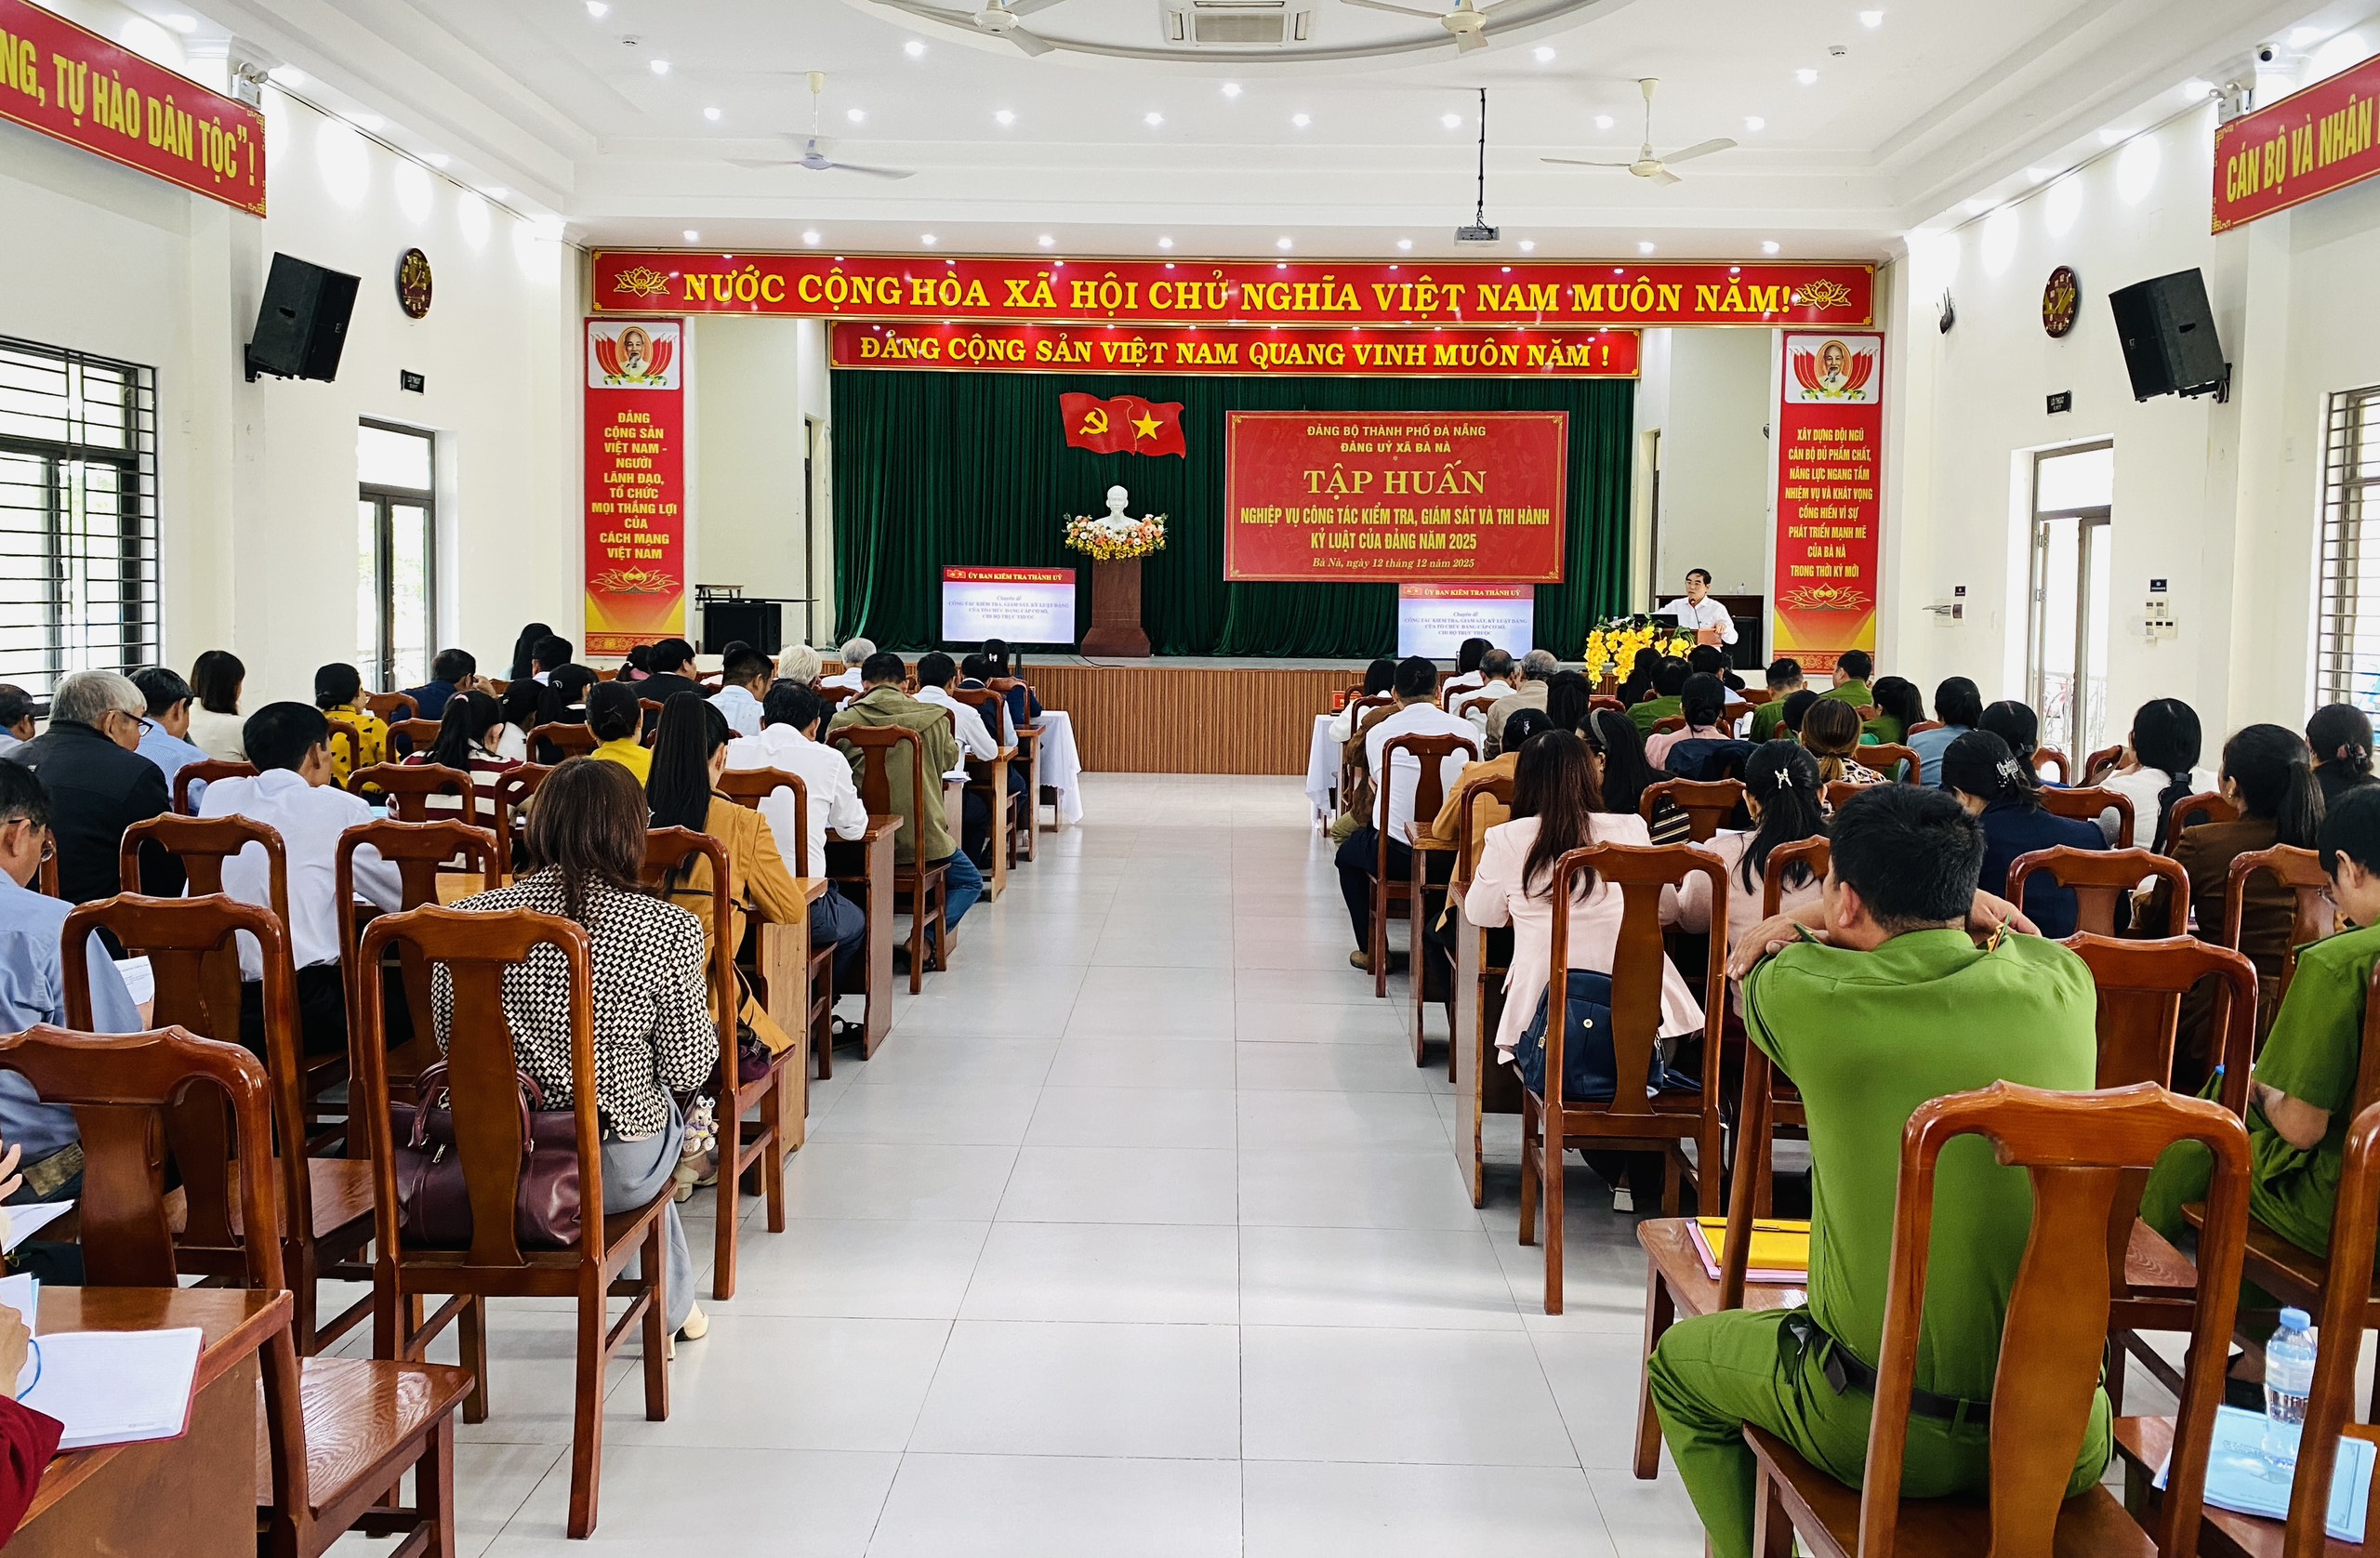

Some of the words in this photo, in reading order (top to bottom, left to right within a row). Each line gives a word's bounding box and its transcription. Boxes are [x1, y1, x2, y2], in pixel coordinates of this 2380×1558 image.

[53, 53, 87, 127] TỰ
[93, 70, 140, 139] HÀO
[147, 94, 193, 161] DÂN
[2227, 141, 2260, 203] CÁN
[2264, 125, 2287, 194] BỘ
[2292, 113, 2313, 178] VÀ
[2319, 93, 2373, 168] NHÂN
[683, 264, 786, 303] NƯỚC
[798, 266, 902, 311] CỘNG
[909, 270, 990, 307] HÒA
[1003, 271, 1057, 308] XÃ
[1070, 271, 1139, 317] HỘI
[1148, 269, 1229, 310] CHỦ
[1240, 274, 1362, 311] NGHĨA
[1371, 274, 1466, 320] VIỆT
[1476, 284, 1560, 311] NAM
[1571, 275, 1683, 312] MUÔN
[1695, 276, 1791, 313] NĂM!
[860, 329, 941, 360] ĐẢNG
[947, 332, 1026, 364] CỘNG
[1036, 332, 1093, 363] SẢN
[1100, 337, 1169, 368] VIỆT
[1176, 342, 1238, 364] NAM
[1249, 341, 1345, 370] QUANG
[1352, 344, 1426, 366] VINH
[1434, 337, 1519, 366] MUÔN
[1527, 337, 1591, 367] NĂM
[618, 409, 650, 423] ĐẢNG
[604, 426, 636, 440] CỘNG
[640, 425, 664, 439] SẢN
[1307, 424, 1340, 436] ĐẢNG
[1343, 425, 1358, 438] BỘ
[1363, 425, 1402, 436] THÀNH
[1406, 423, 1431, 436] PHỐ
[1434, 425, 1449, 436] ĐÀ
[1453, 423, 1486, 436] NẴNG
[1797, 427, 1812, 441] XÂY
[1813, 429, 1833, 443] DỰNG
[1834, 427, 1846, 443] ĐỘI
[604, 441, 628, 456] VIỆT
[632, 443, 659, 454] NAM
[1340, 441, 1373, 453] ĐẢNG
[1377, 441, 1393, 453] UỶ
[1395, 441, 1411, 453] XÃ
[1415, 441, 1431, 453] BÀ
[1435, 441, 1451, 453] NÀ
[1788, 446, 1804, 460] CÁN
[1805, 446, 1816, 463] BỘ
[1817, 445, 1827, 460] ĐỦ
[1829, 444, 1850, 460] PHẨM
[615, 456, 652, 469] NGƯỜI
[603, 470, 634, 483] LÃNH
[638, 473, 664, 486] ĐẠO,
[1303, 462, 1373, 500] TẬP
[1383, 459, 1488, 495] HUẤN
[1790, 466, 1810, 480] NĂNG
[1812, 467, 1826, 482] LỰC
[1827, 469, 1852, 480] NGANG
[609, 483, 624, 498] TỔ
[627, 486, 659, 498] CHỨC
[1785, 484, 1809, 501] NHIỆM
[1810, 487, 1820, 502] VỤ
[1821, 485, 1831, 499] VÀ
[1832, 485, 1852, 500] KHÁT
[1853, 488, 1873, 502] VỌNG
[591, 502, 615, 515] MỌI
[617, 499, 655, 514] THẮNG
[659, 503, 677, 516] LỢI
[1240, 504, 1282, 527] NGHIỆP
[1285, 508, 1300, 527] VỤ
[1302, 505, 1334, 524] CÔNG
[1337, 505, 1358, 524] TÁC
[1361, 502, 1390, 524] KIỂM
[1394, 508, 1418, 526] TRA,
[1421, 505, 1451, 525] GIÁM
[1454, 505, 1476, 525] SÁT
[1478, 505, 1494, 525] VÀ
[1497, 508, 1514, 525] THI
[1517, 505, 1550, 525] HÀNH
[1798, 503, 1818, 519] CỐNG
[1820, 504, 1837, 519] HIẾN
[1847, 507, 1859, 522] SỰ
[624, 515, 648, 529] CỦA
[600, 531, 631, 543] CÁCH
[634, 533, 669, 546] MẠNG
[1311, 527, 1326, 548] KỶ
[1329, 529, 1356, 552] LUẬT
[1358, 527, 1382, 549] CỦA
[1384, 528, 1416, 549] ĐẢNG
[1419, 530, 1447, 549] NĂM
[1449, 534, 1477, 549] 2025
[1789, 523, 1807, 538] PHÁT
[1809, 522, 1830, 538] TRIỂN
[1831, 527, 1853, 541] MẠNH
[607, 546, 631, 561] VIỆT
[635, 548, 663, 560] NAM
[1807, 542, 1822, 557] CỦA
[1823, 543, 1833, 558] BÀ
[1313, 558, 1326, 567] Bà
[1328, 558, 1344, 568] Nà,
[1346, 558, 1370, 569] ngày
[1372, 559, 1383, 568] 12
[1385, 558, 1414, 569] tháng
[1416, 559, 1428, 568] 12
[1429, 558, 1450, 568] năm
[1453, 559, 1474, 568] 2025
[1791, 564, 1815, 576] TRONG
[1816, 562, 1831, 576] THỜI
